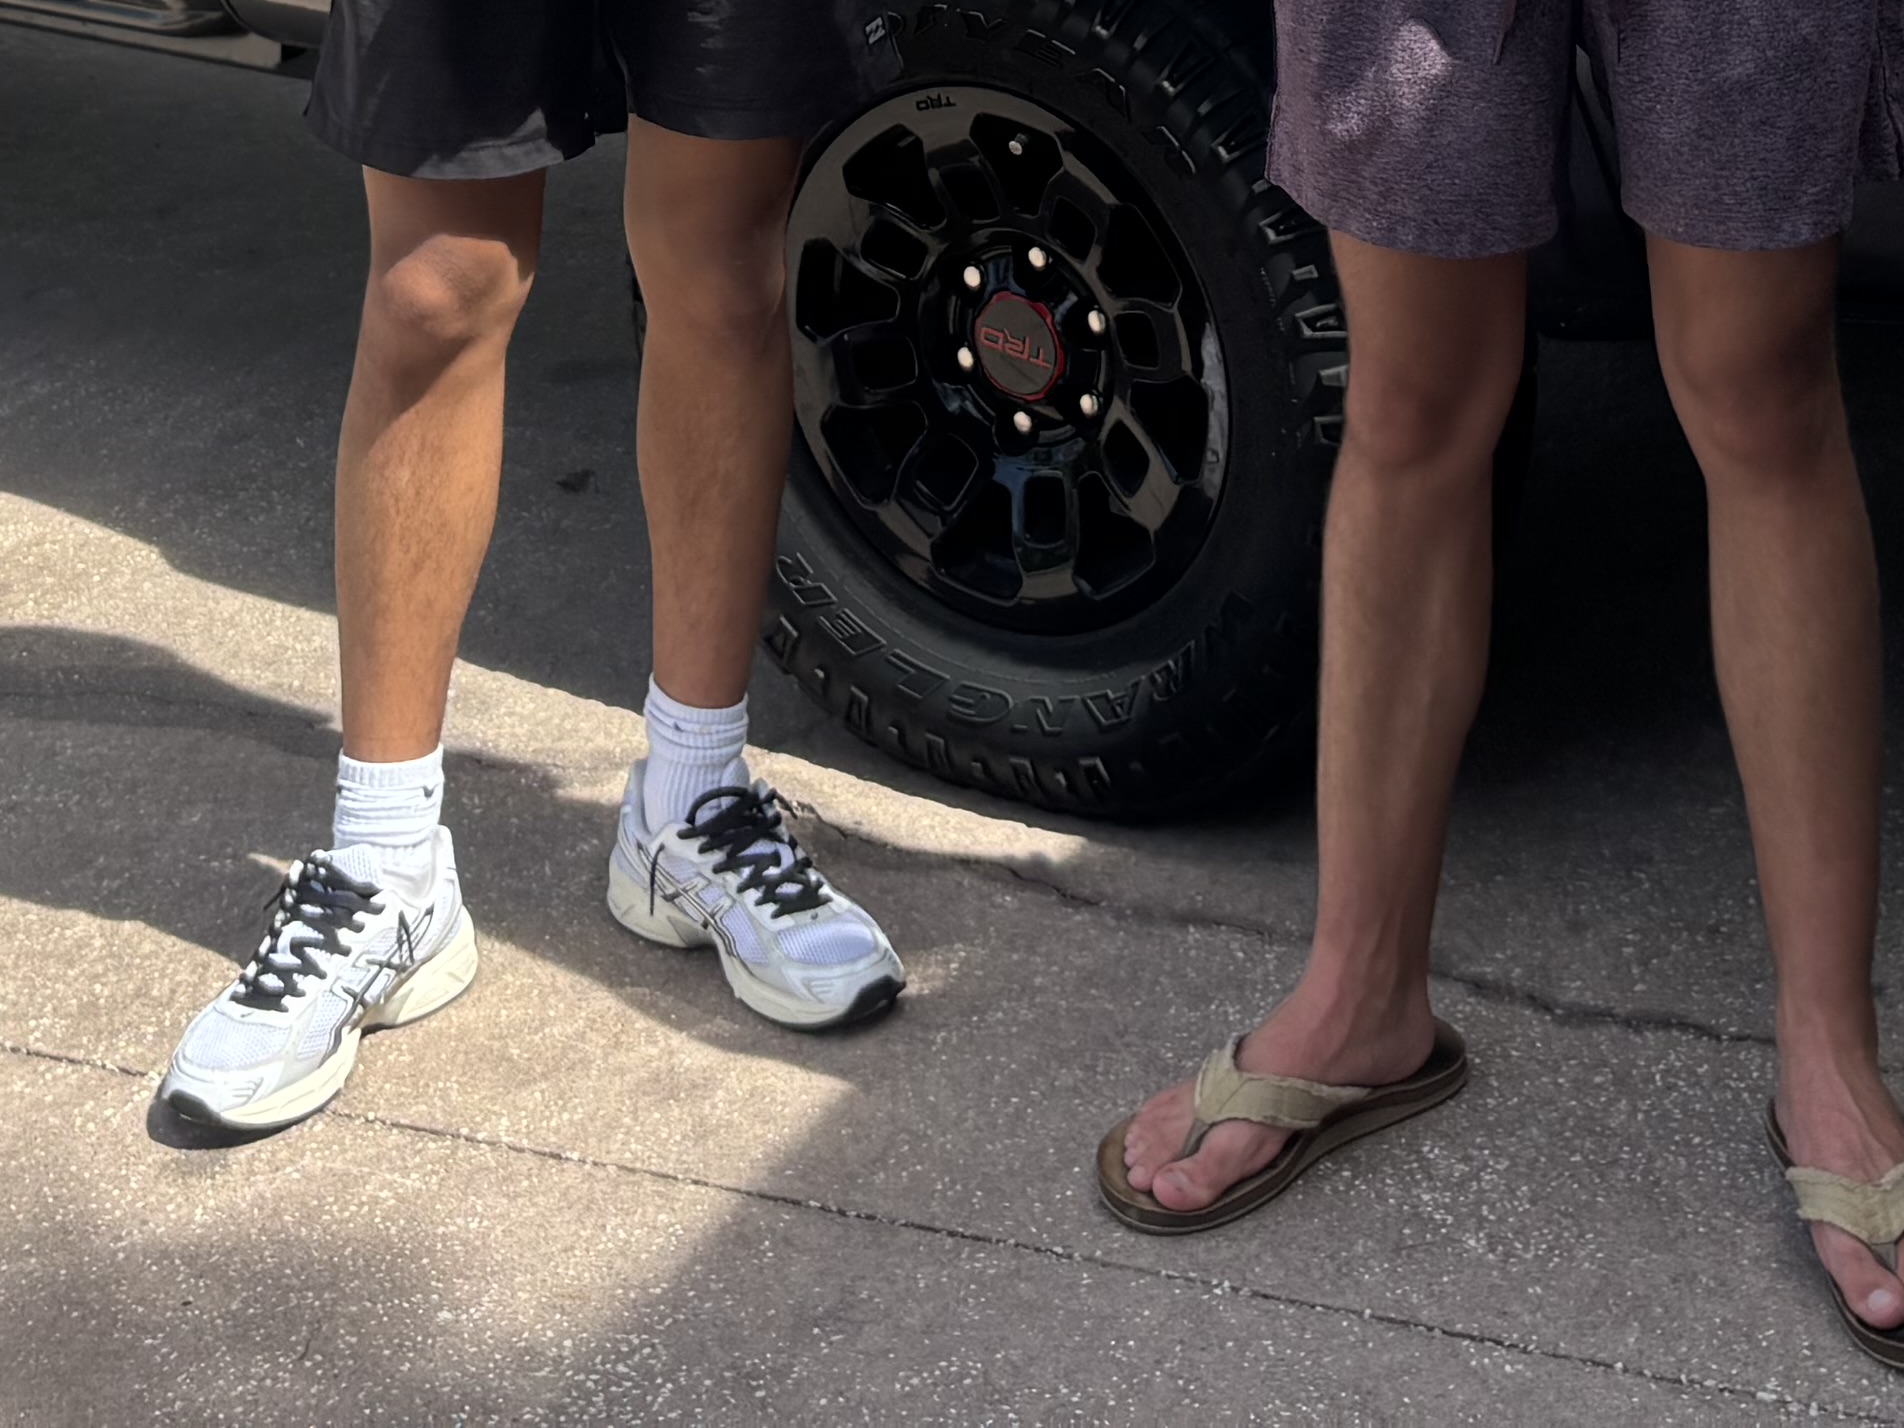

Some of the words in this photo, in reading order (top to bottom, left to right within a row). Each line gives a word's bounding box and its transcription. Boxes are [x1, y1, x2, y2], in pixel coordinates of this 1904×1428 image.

[915, 93, 957, 112] TRD
[978, 326, 1053, 370] TRD
[775, 551, 1252, 737] WRANGLER
